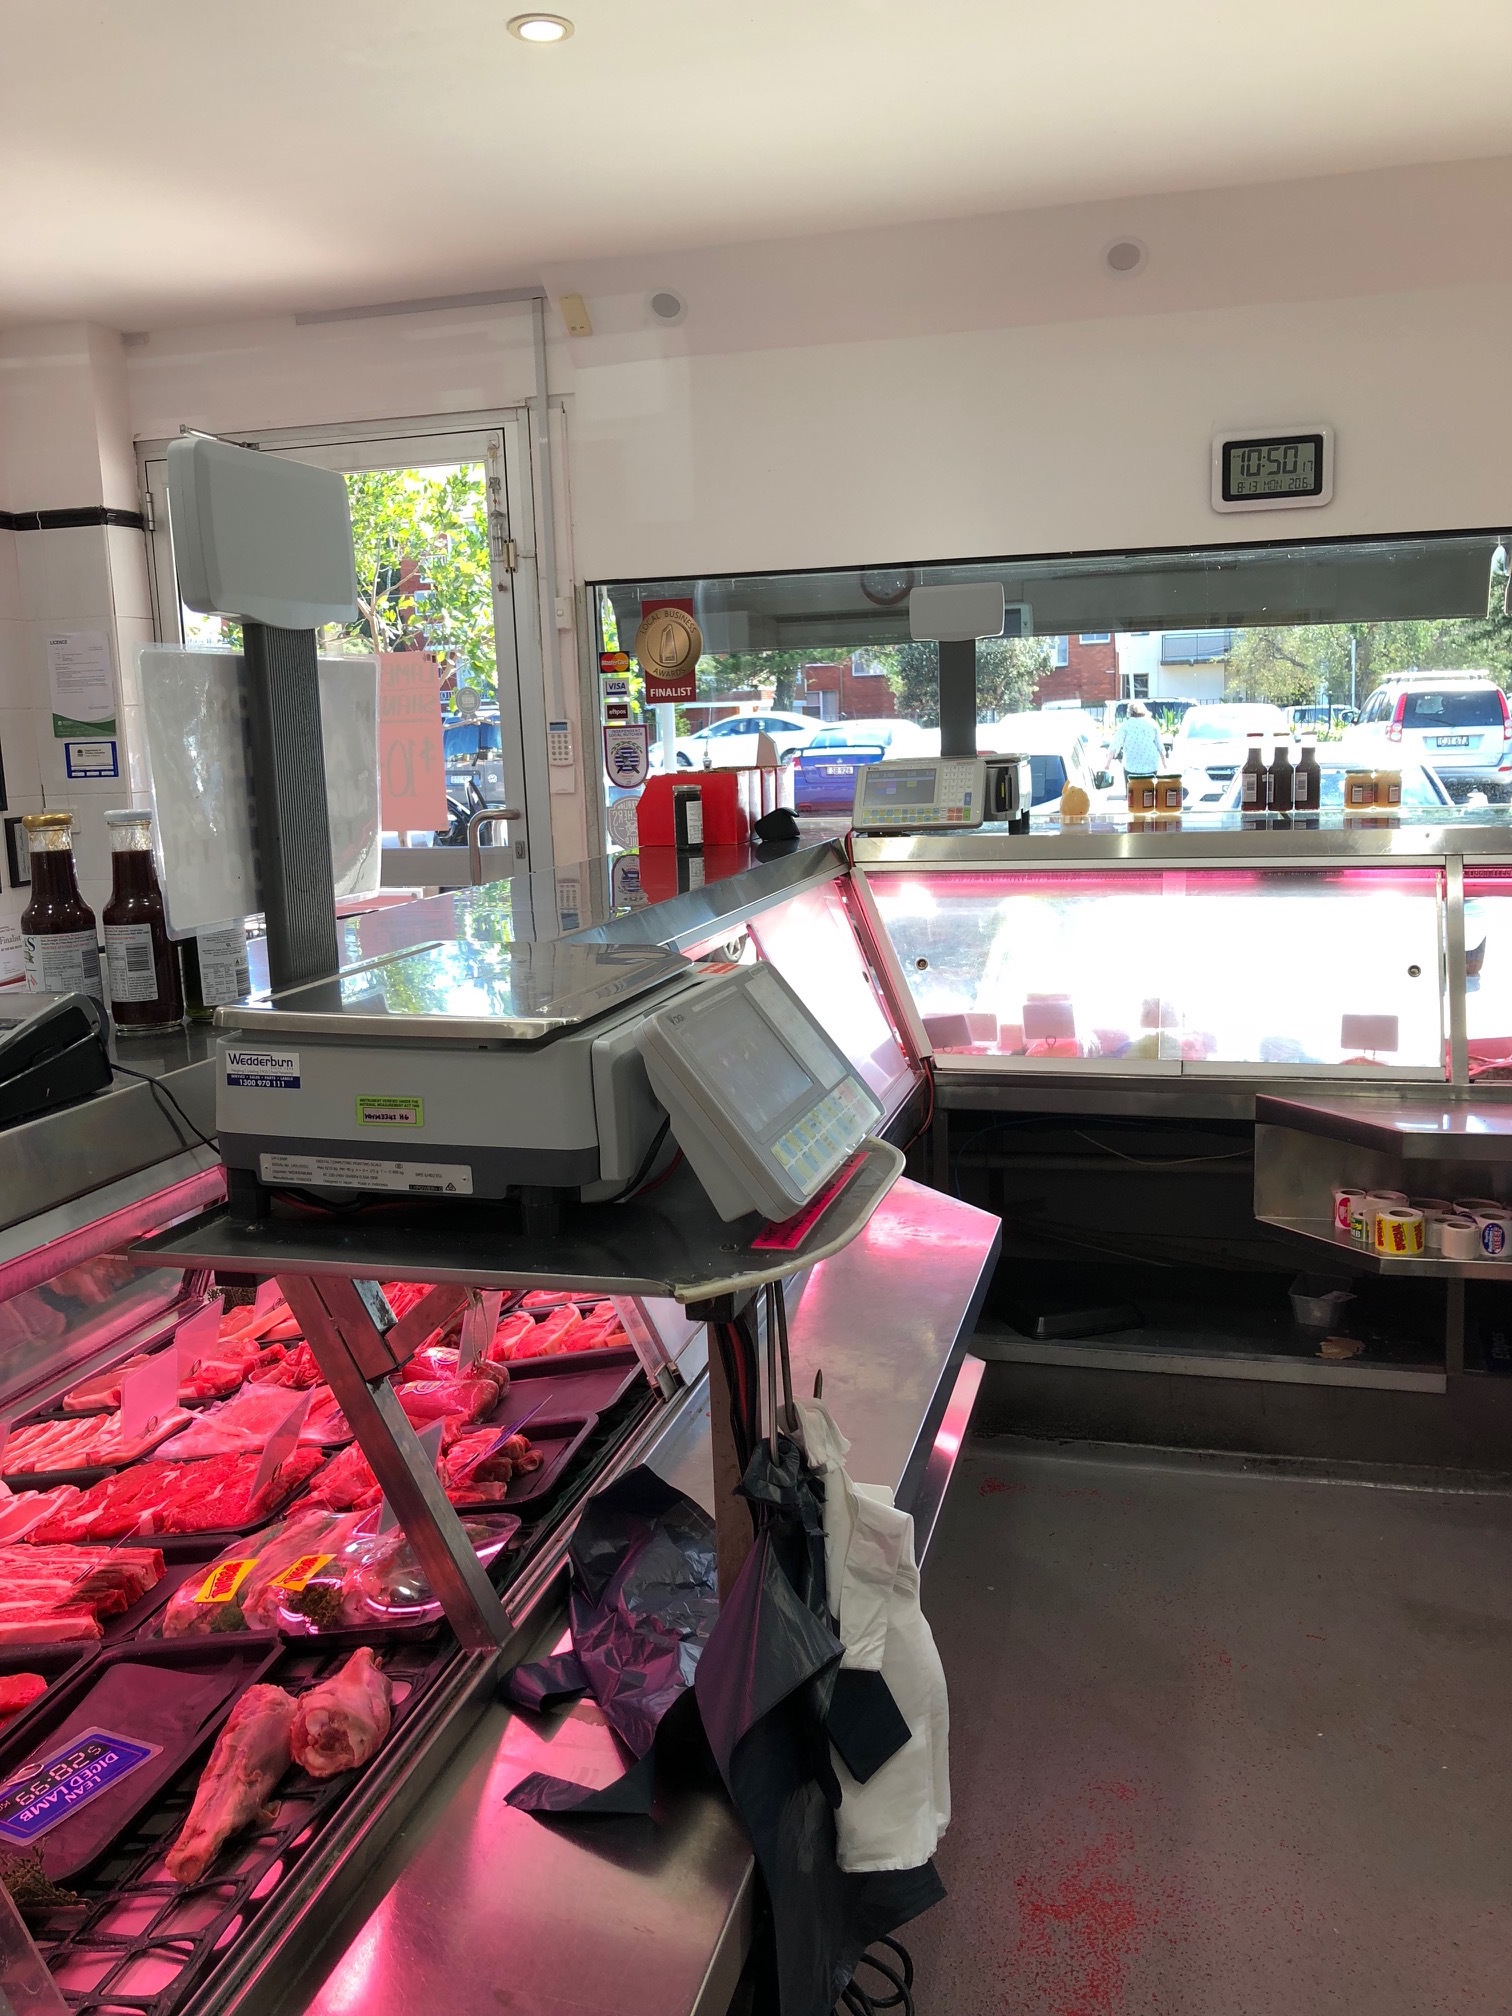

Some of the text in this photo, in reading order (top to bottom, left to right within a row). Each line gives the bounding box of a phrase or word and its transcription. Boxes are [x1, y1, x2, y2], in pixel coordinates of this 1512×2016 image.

[1240, 445, 1313, 477] 10:50 17
[1263, 479, 1283, 491] MON
[640, 610, 697, 635] LOCAL BUSINESS
[601, 658, 629, 667] MasterCard
[652, 666, 686, 678] AWARDS
[608, 682, 627, 691] VISA
[650, 686, 693, 698] FINALIST
[608, 707, 627, 716] eftpos
[228, 1053, 294, 1068] Wedderburn
[19, 1752, 120, 1822] DICED LAMB
[65, 1775, 102, 1803] LEAN
